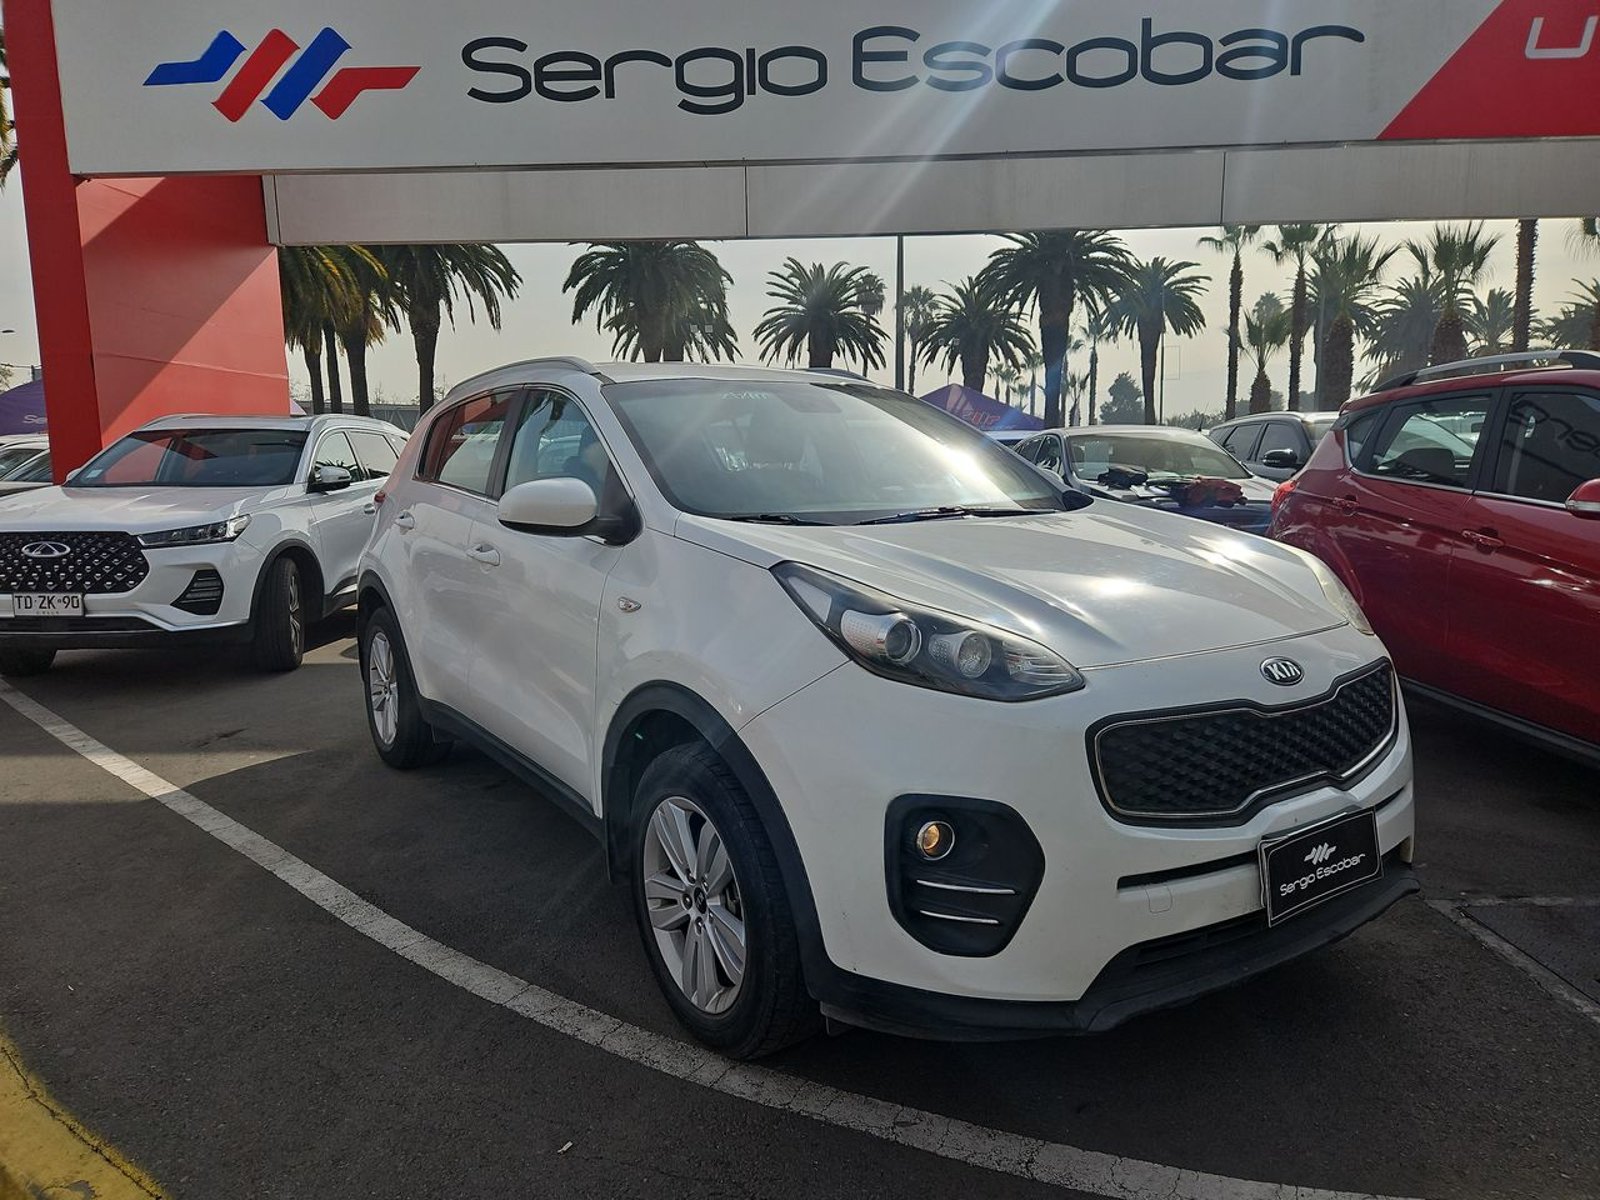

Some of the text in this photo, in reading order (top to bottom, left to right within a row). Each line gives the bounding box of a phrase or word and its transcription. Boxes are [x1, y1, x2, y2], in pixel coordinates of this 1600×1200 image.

[461, 16, 1366, 116] Sergio Escobar
[1266, 660, 1302, 681] KIA
[1315, 852, 1367, 880] Escobar
